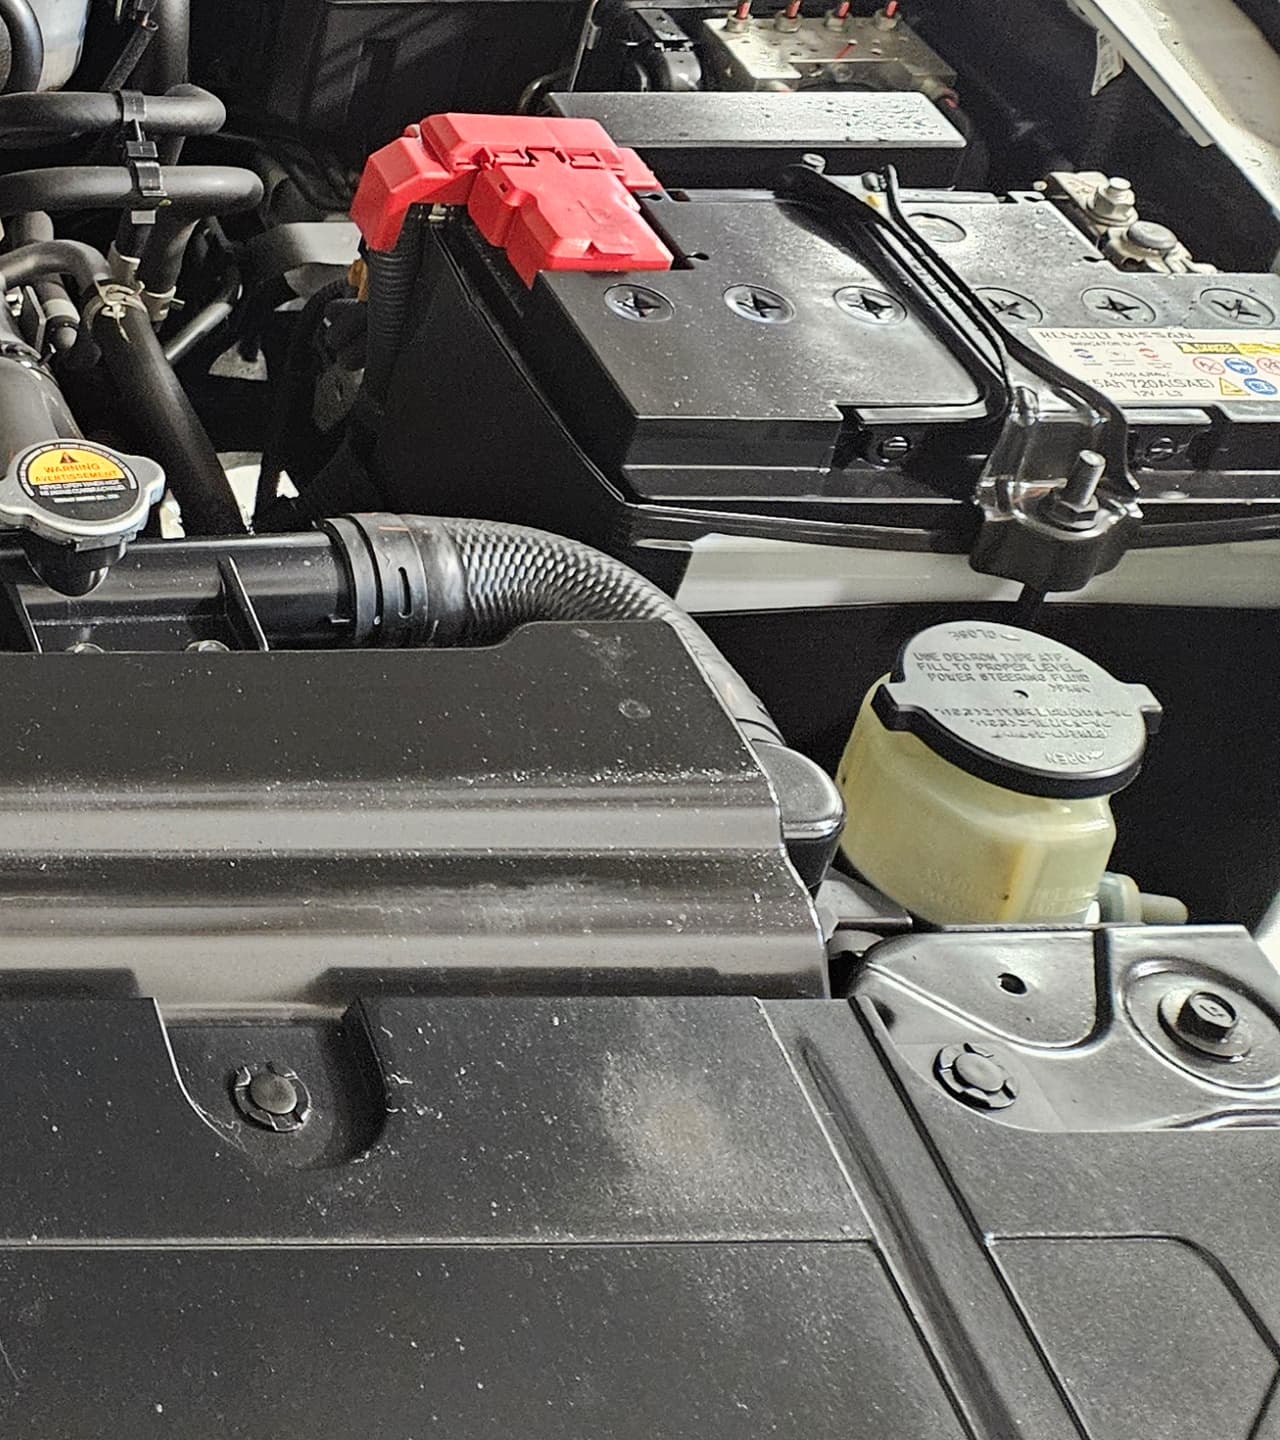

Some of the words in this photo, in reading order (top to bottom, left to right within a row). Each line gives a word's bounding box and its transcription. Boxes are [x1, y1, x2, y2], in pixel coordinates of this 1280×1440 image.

[1119, 331, 1194, 340] NISSAN
[43, 464, 100, 473] WARNING
[35, 471, 118, 482] AVERTISSEMENT
[917, 663, 950, 671] FILL
[956, 663, 971, 671] TO
[976, 663, 1027, 672] PROPER
[928, 673, 975, 682] POWER
